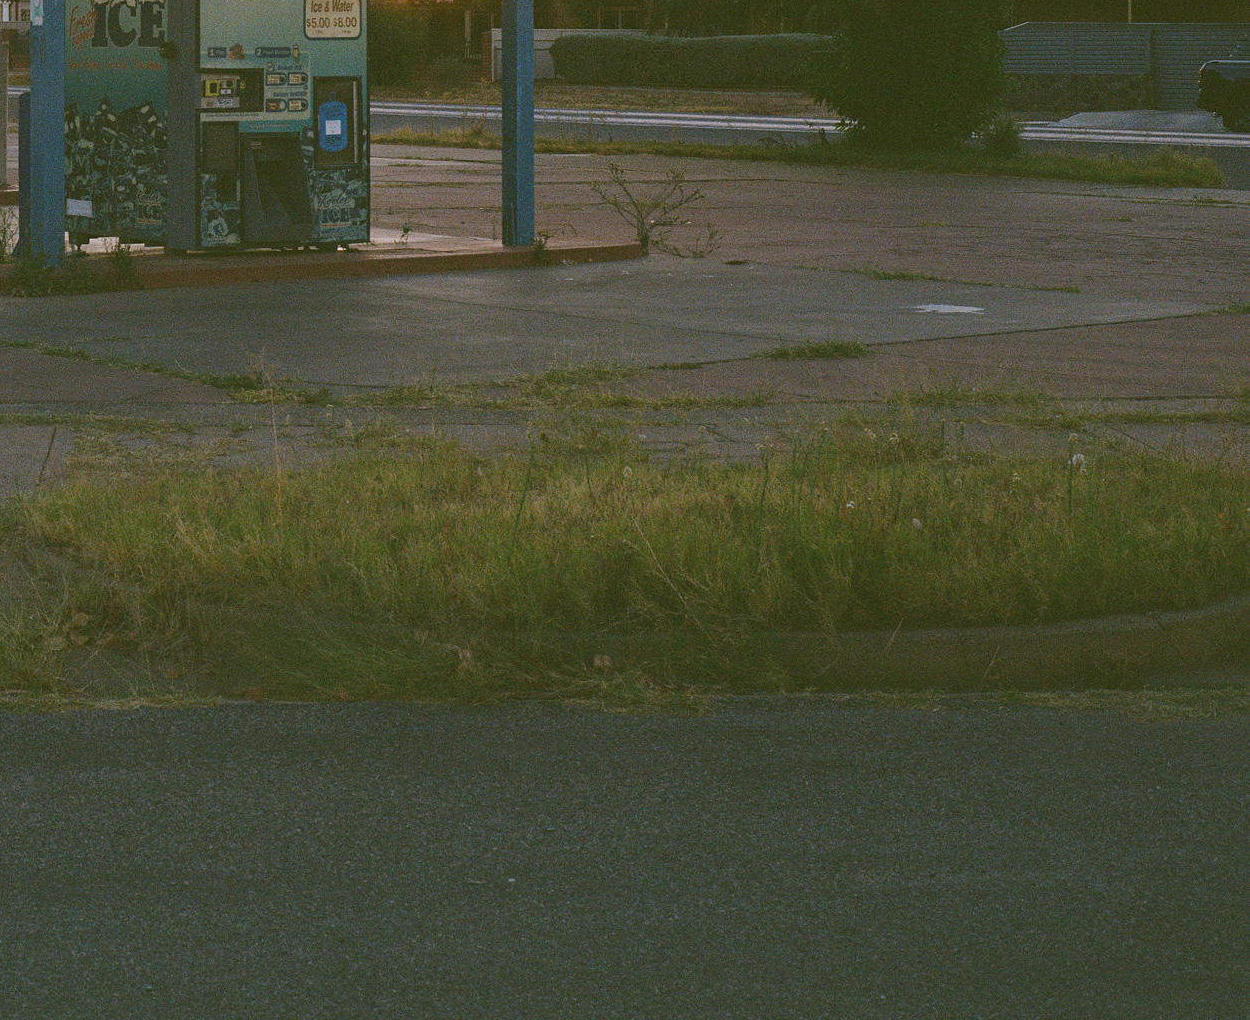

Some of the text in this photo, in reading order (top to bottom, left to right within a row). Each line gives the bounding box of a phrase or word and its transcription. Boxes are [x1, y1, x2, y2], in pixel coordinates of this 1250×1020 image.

[310, 0, 354, 13] Ice & Water
[306, 16, 358, 29] $5.00 $8.00
[256, 49, 262, 57] 2
[321, 207, 350, 223] ICE
